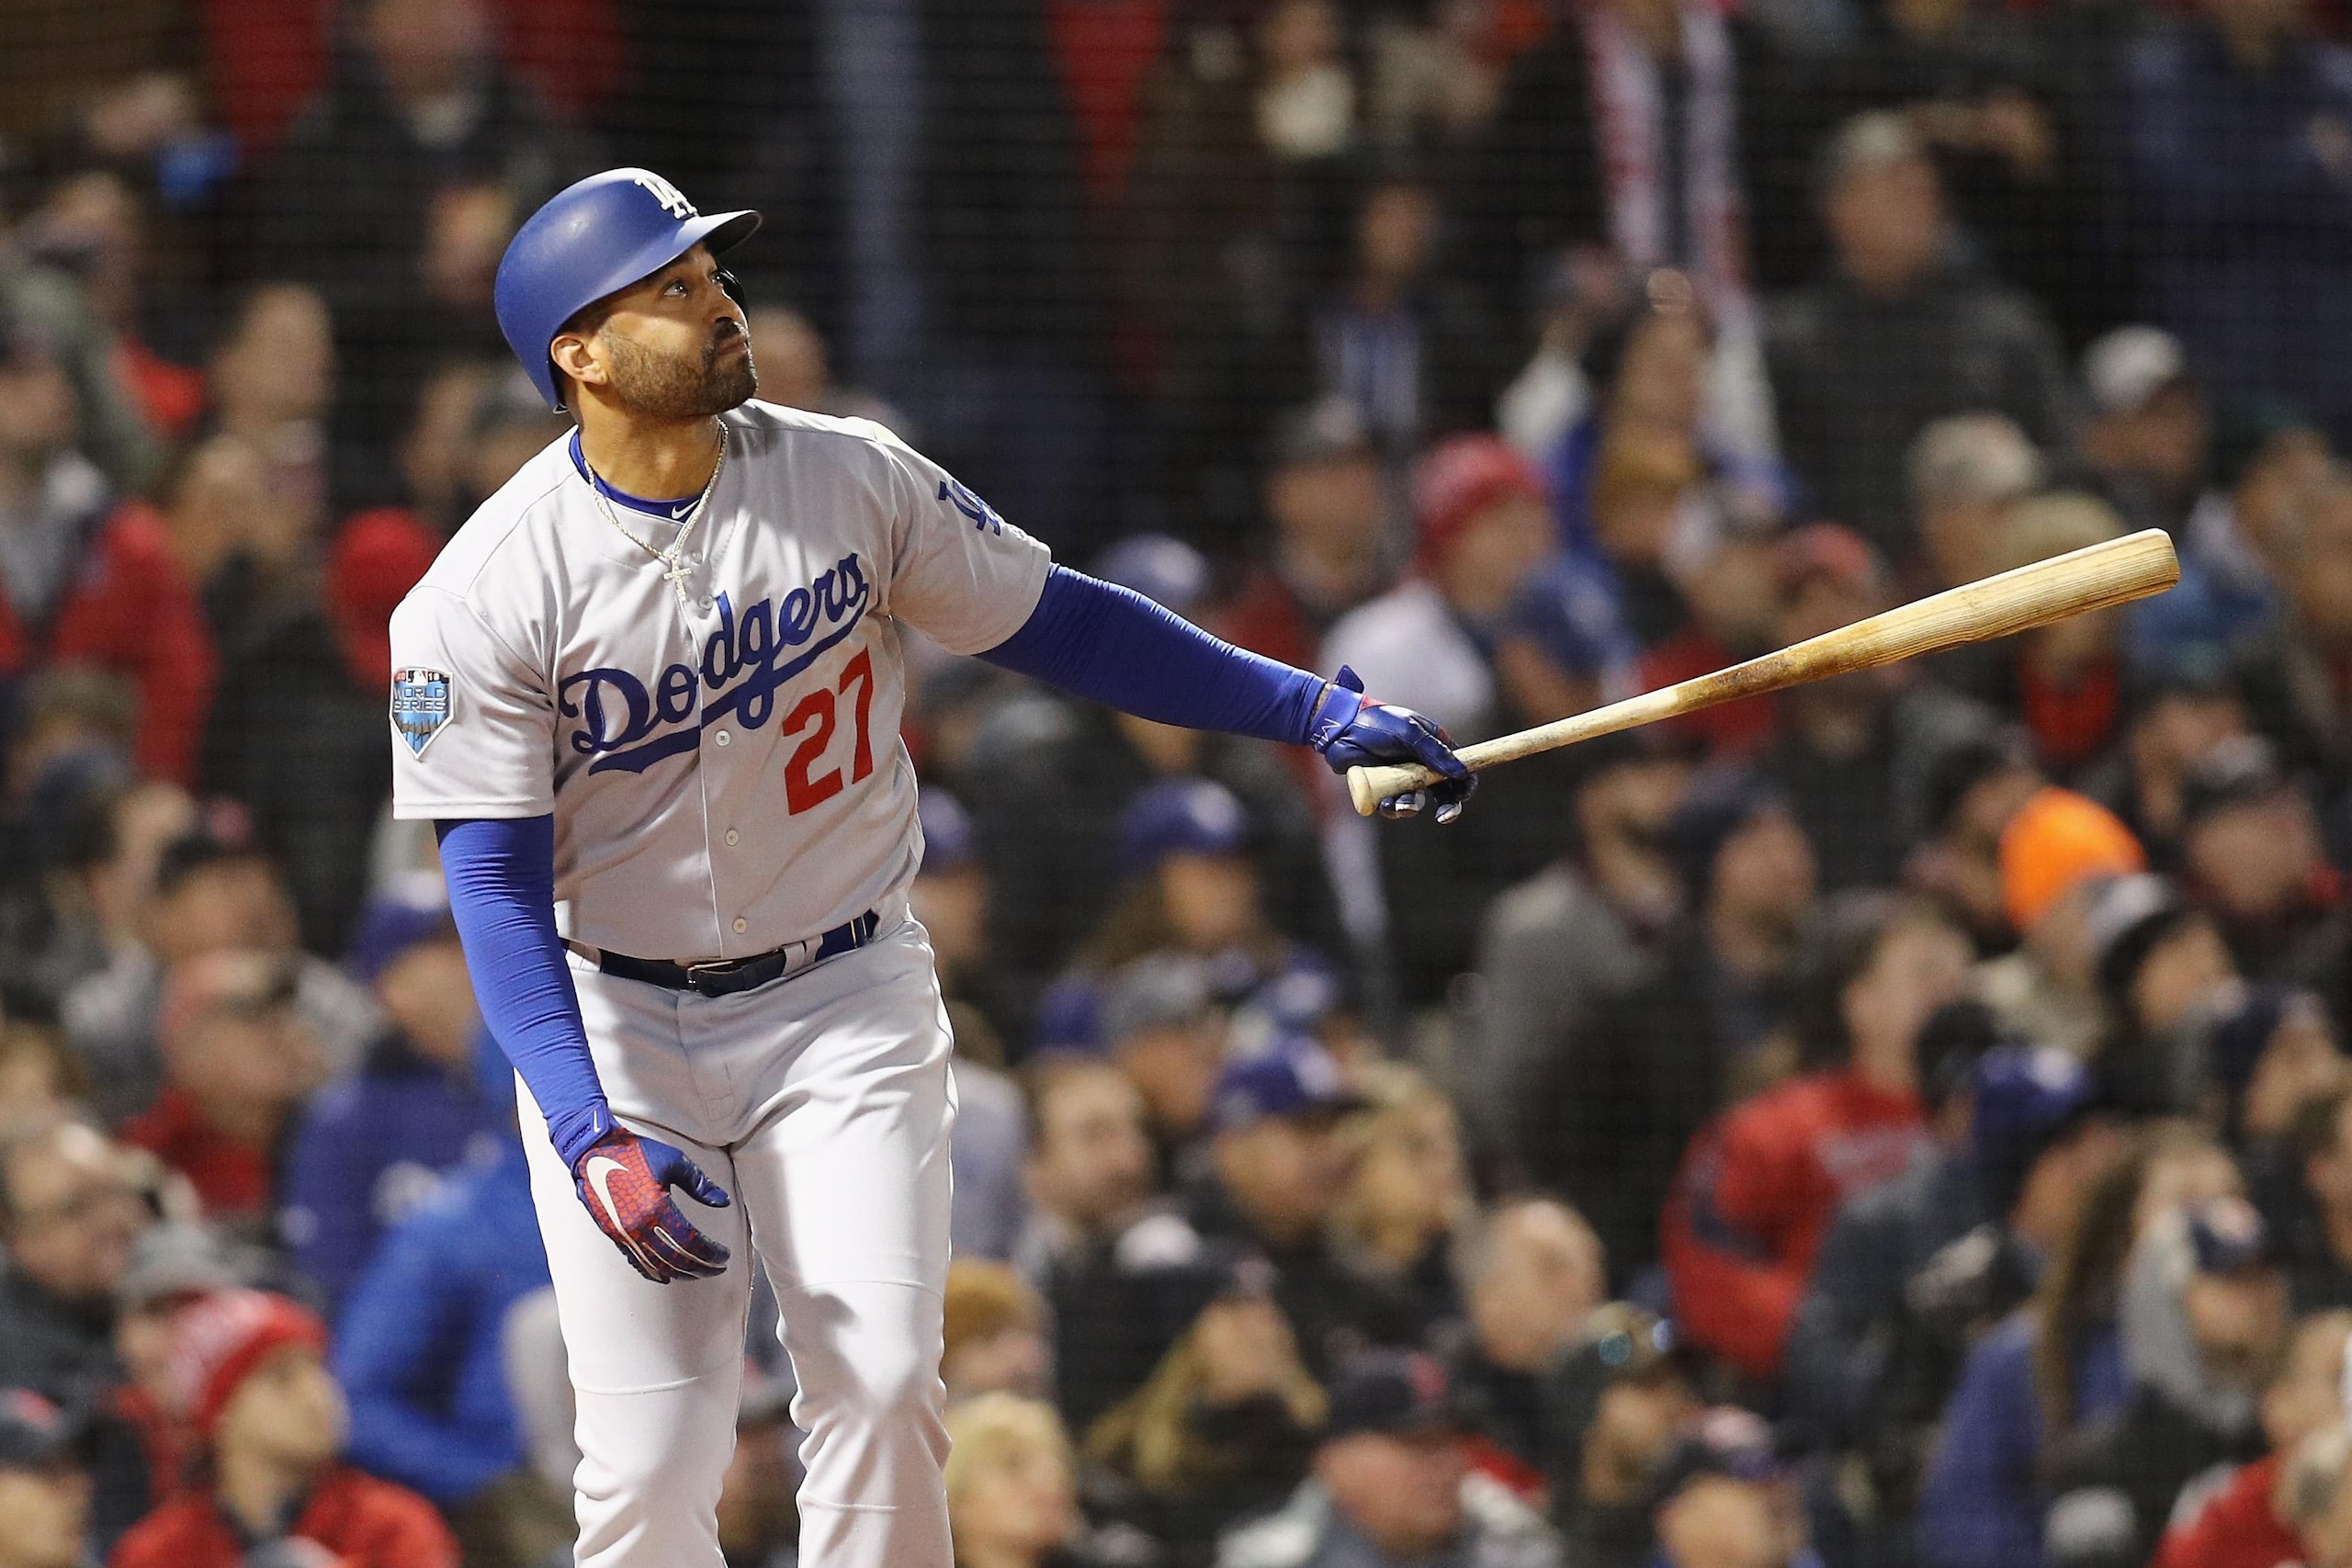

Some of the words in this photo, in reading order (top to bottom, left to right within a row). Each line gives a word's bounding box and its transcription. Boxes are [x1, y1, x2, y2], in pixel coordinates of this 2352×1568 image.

[634, 178, 697, 219] LA
[558, 553, 870, 755] Dodgers
[394, 687, 447, 700] WORLD
[394, 701, 446, 713] SERIES
[783, 645, 874, 816] 27
